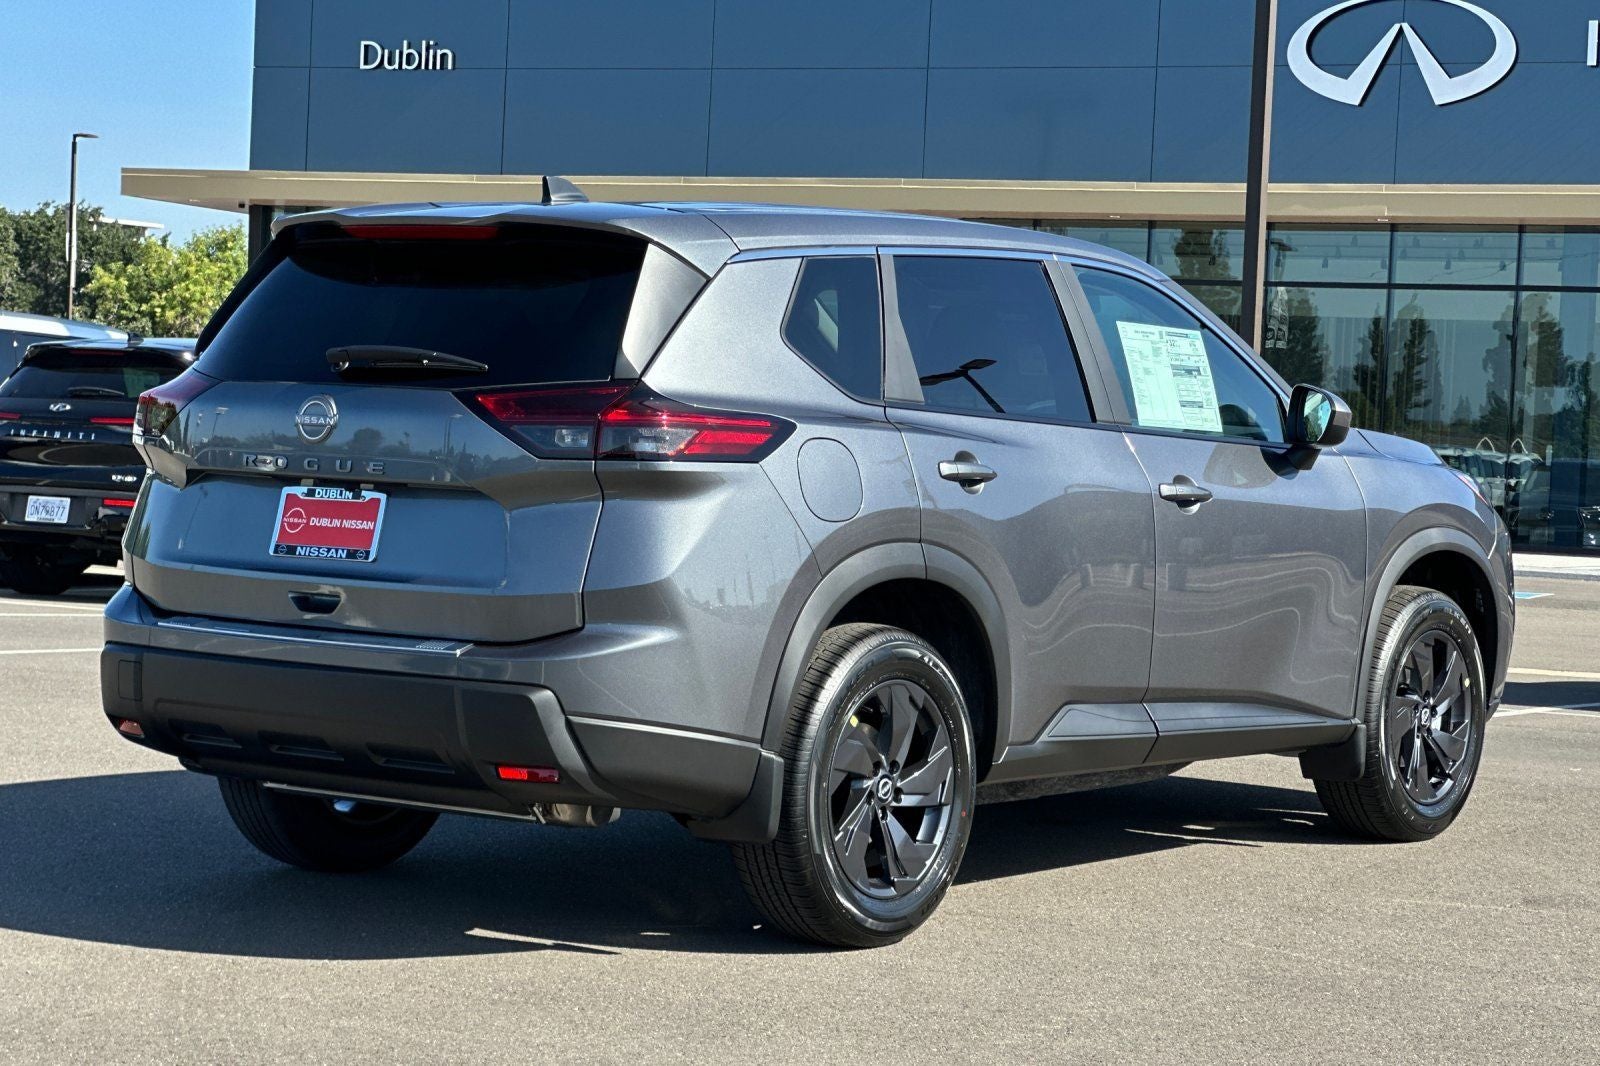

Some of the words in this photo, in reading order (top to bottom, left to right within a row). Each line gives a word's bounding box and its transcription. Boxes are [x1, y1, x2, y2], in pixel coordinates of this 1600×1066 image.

[359, 40, 453, 70] Dublin
[296, 415, 336, 425] NISSAN
[10, 429, 96, 440] INFINITI
[243, 454, 385, 475] ROGUE
[314, 488, 353, 500] DUBLIN
[309, 517, 340, 528] DUBLIN
[342, 519, 375, 530] NISSAN
[295, 546, 347, 558] NISSAN
